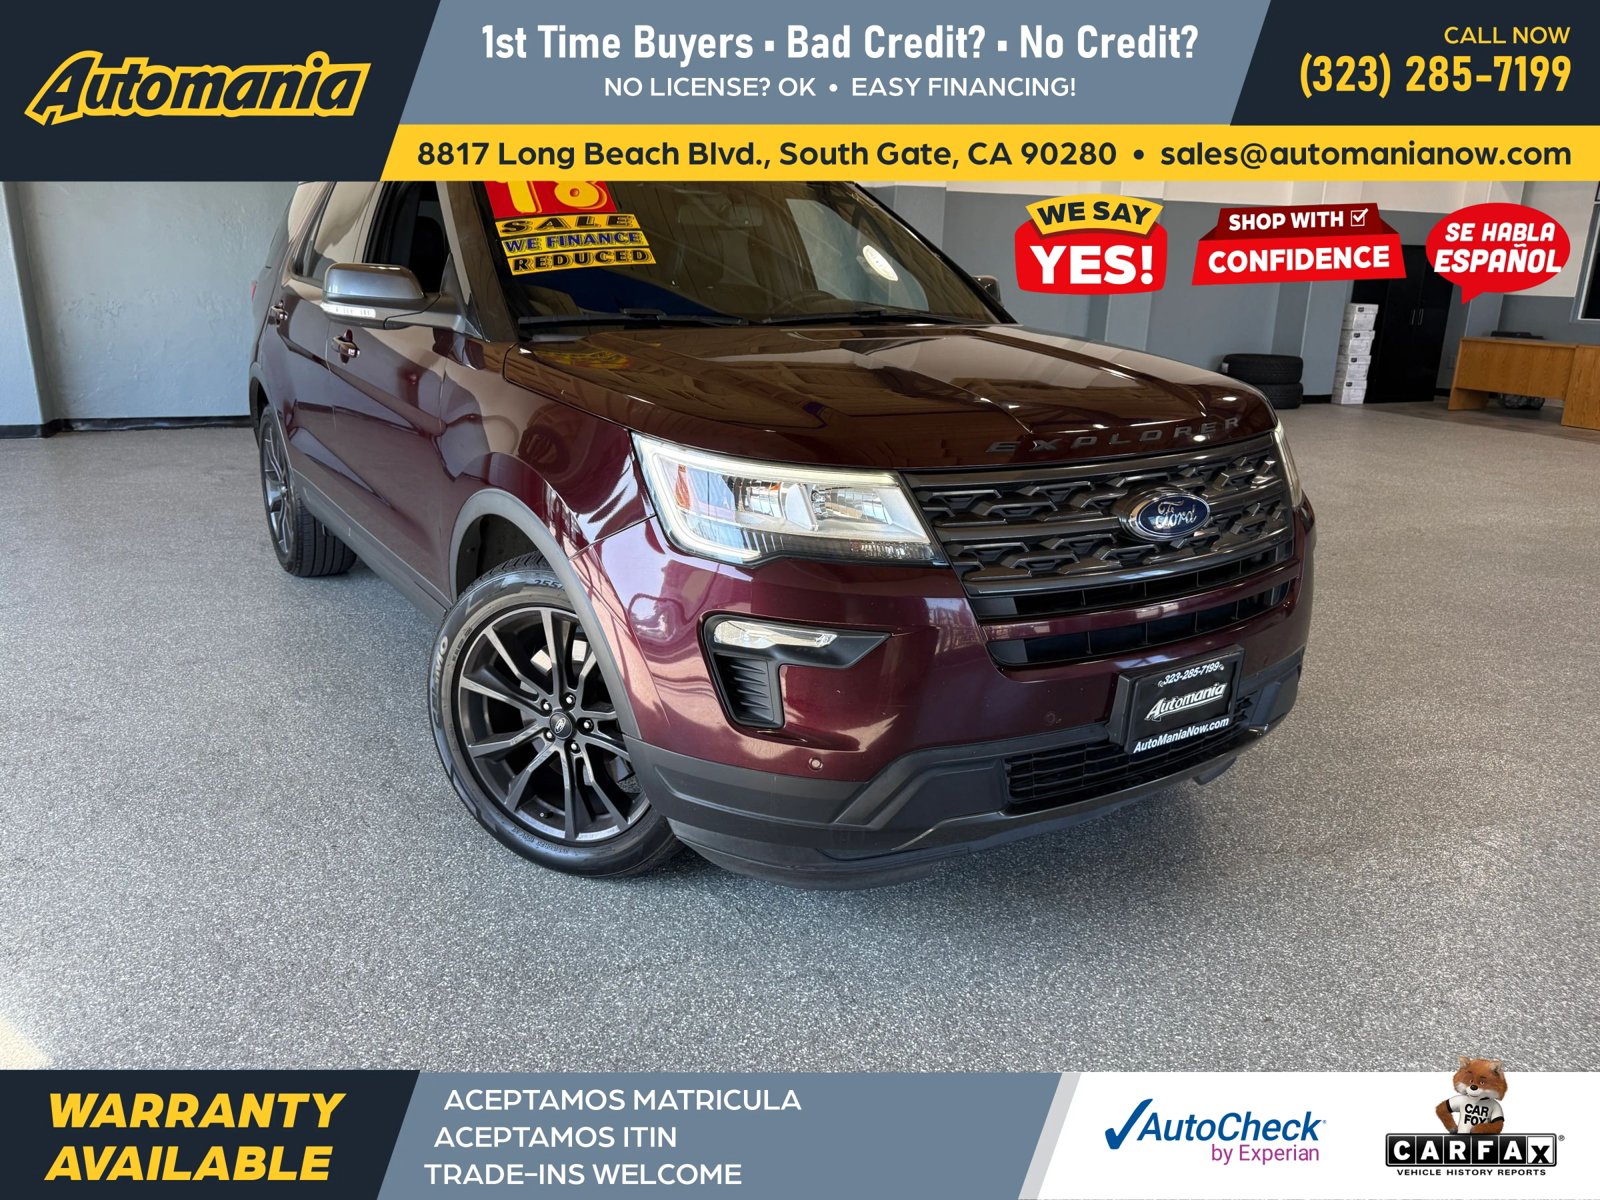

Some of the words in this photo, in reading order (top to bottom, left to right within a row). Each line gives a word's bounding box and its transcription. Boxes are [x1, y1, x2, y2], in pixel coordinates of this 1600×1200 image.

[500, 215, 634, 234] SALE
[504, 237, 542, 253] WE
[546, 232, 646, 249] FINANCE
[513, 250, 650, 273] REDUCED
[985, 417, 1240, 453] EXPLORER
[1156, 500, 1198, 529] Ford
[1162, 661, 1220, 686] 323-285-7199
[1144, 682, 1228, 721] Automania
[1133, 717, 1229, 754] AutoManiaNow.com
